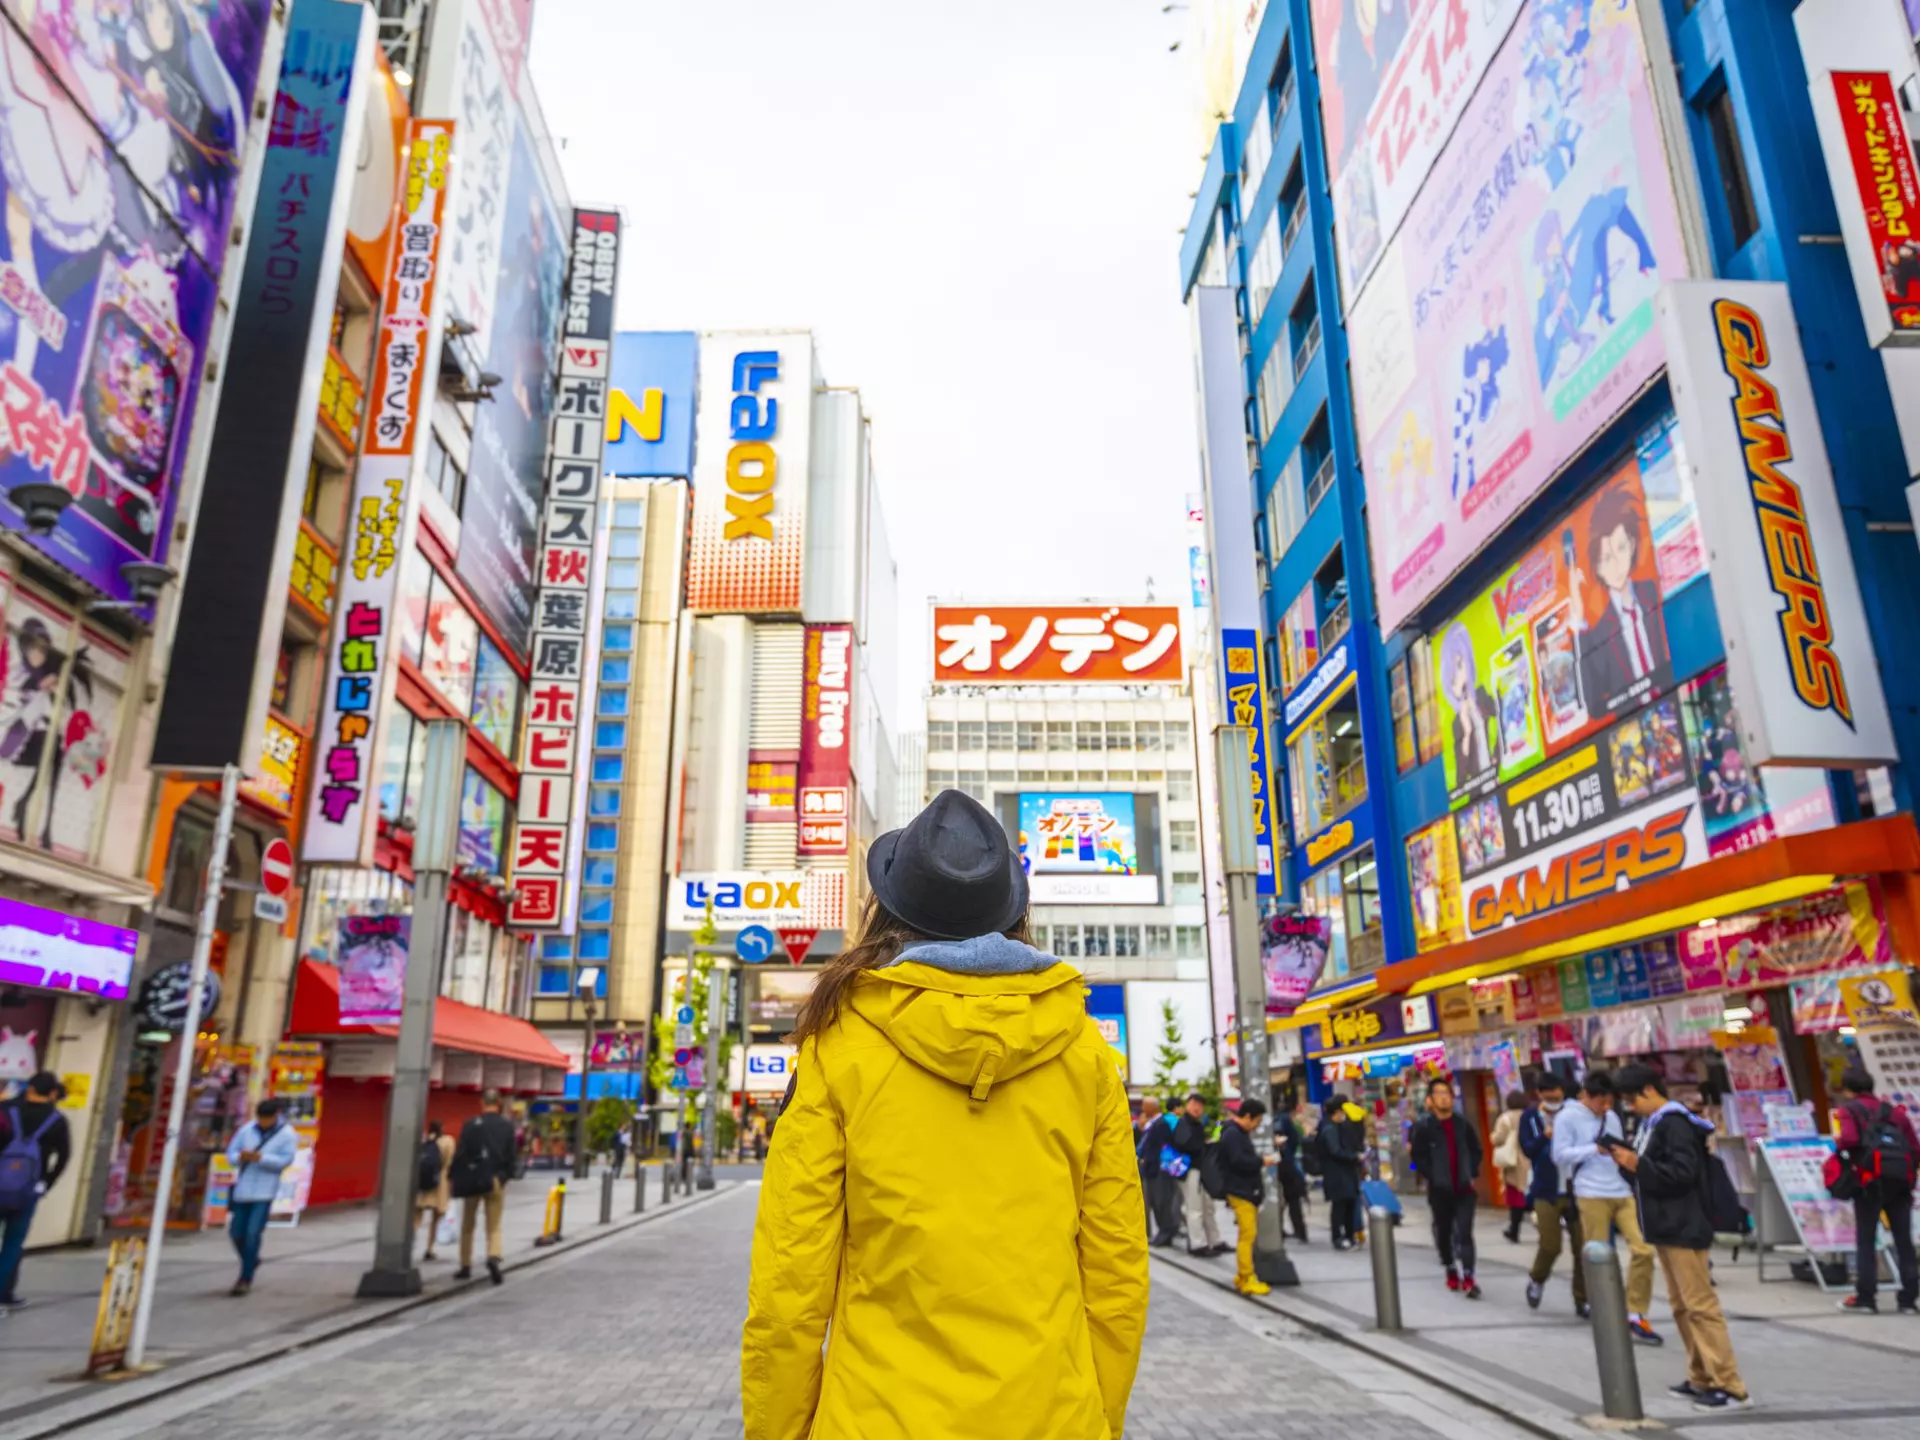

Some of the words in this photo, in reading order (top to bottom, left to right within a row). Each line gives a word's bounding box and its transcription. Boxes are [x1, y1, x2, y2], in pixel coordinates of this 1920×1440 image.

[566, 212, 598, 335] PARADISE
[1711, 298, 1857, 734] GAMERS
[937, 607, 1178, 673] オノデン
[319, 601, 382, 825] とれじゃらす
[1469, 803, 1695, 934] GAMERS
[1512, 782, 1581, 849] 11.30
